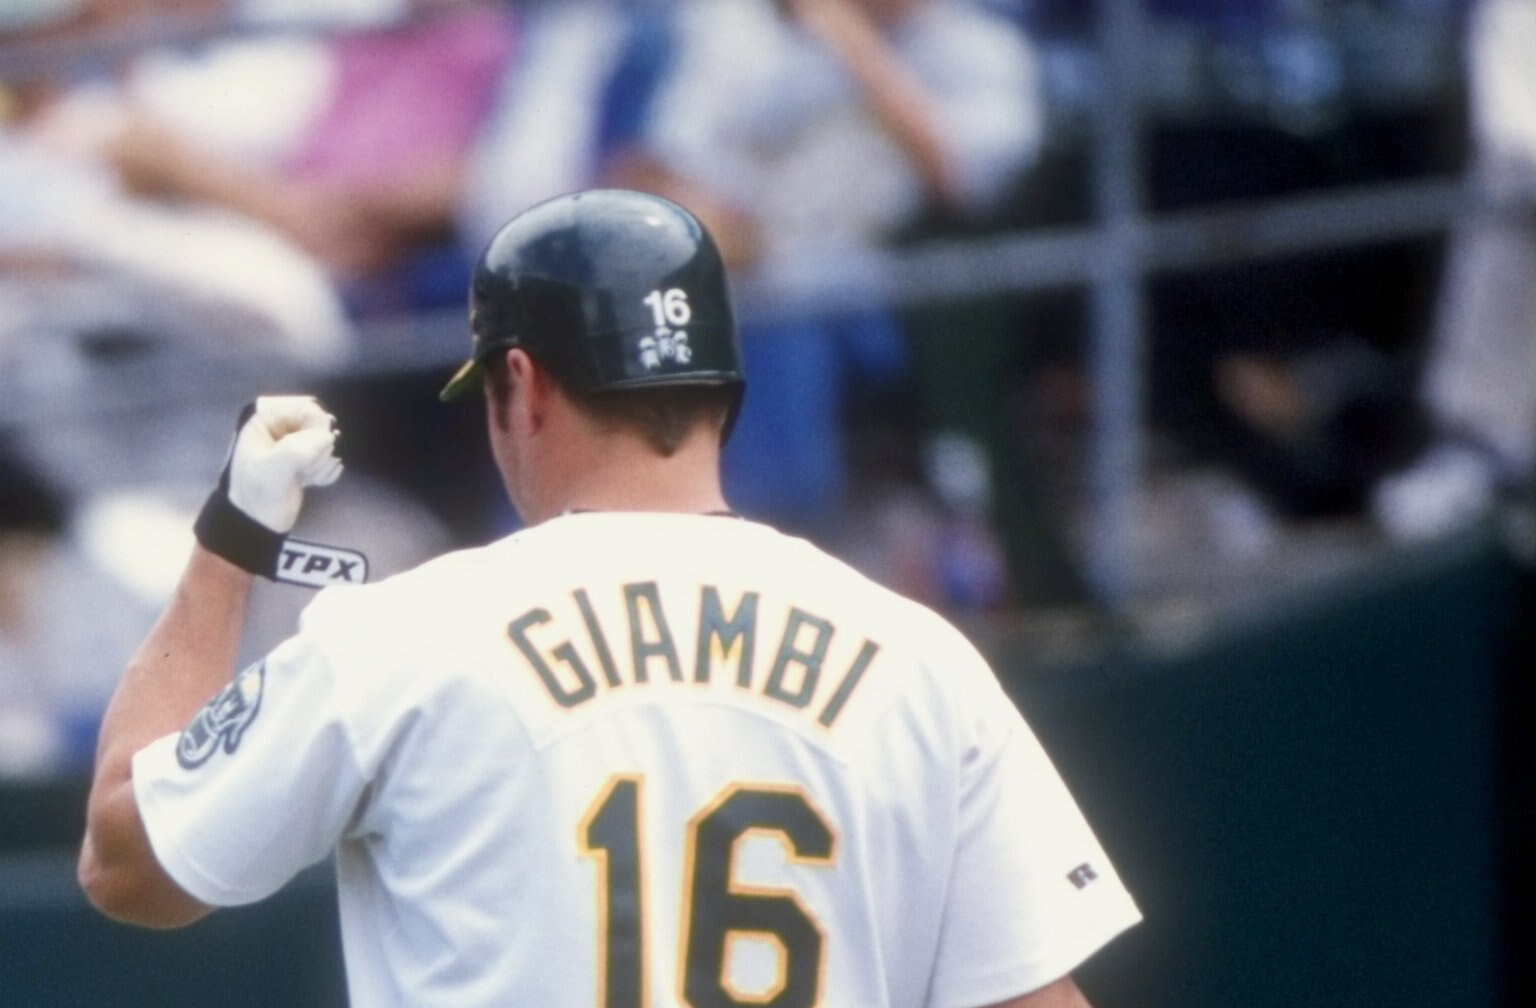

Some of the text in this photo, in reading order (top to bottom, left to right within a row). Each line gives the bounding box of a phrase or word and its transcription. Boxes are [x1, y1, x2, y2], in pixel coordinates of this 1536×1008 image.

[643, 288, 691, 326] 16
[282, 550, 358, 581] TPX
[506, 580, 881, 729] GIAMBI
